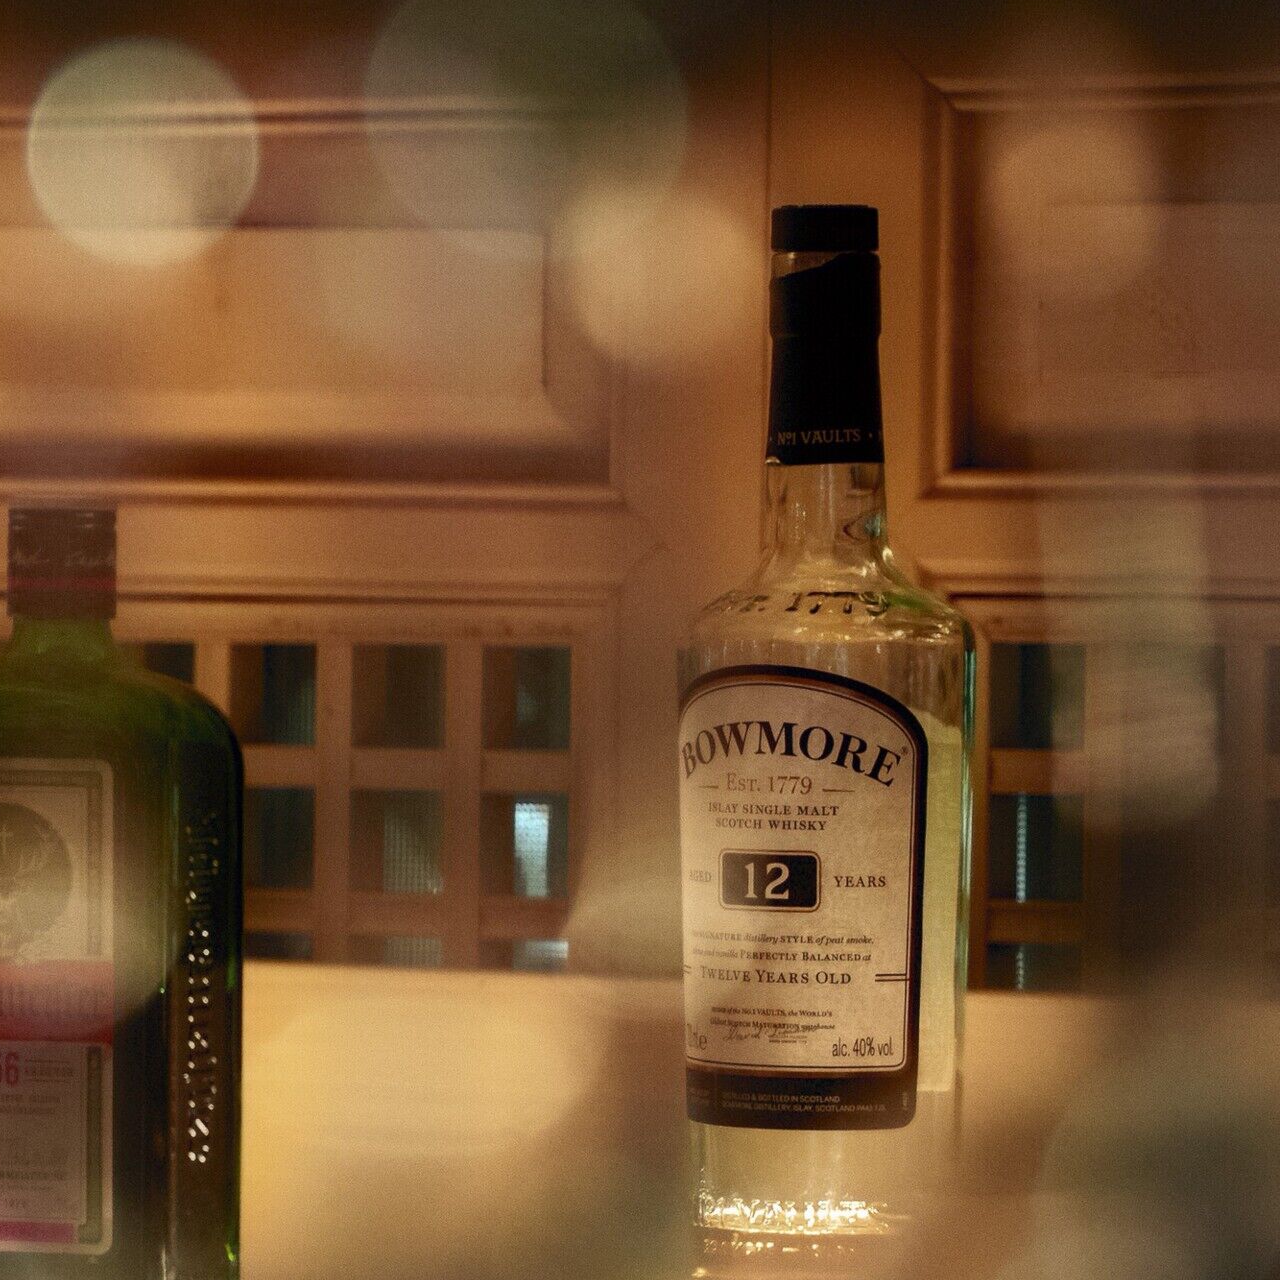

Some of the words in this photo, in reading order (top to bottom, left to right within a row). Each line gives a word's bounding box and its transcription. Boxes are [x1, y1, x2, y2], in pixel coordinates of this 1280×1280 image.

[800, 428, 862, 446] VAULTS
[682, 720, 901, 787] BOWMORE
[768, 775, 813, 795] 1779
[708, 802, 738, 815] ISLAY
[742, 803, 792, 816] SINGLE
[797, 805, 840, 816] MALT
[715, 816, 763, 830] SCOTCH
[768, 819, 827, 831] WHISKY
[744, 862, 791, 901] 12
[833, 874, 887, 888] YEARS
[743, 931, 779, 945] distillery
[780, 935, 814, 944] STYLE
[815, 935, 826, 945] of
[825, 936, 844, 946] peat
[846, 935, 875, 945] smoke,
[739, 949, 798, 962] PERFECTLY
[802, 952, 861, 962] BALANCED
[862, 953, 872, 962] at
[700, 964, 751, 983] TWELVE
[755, 968, 810, 985] YEARS
[815, 970, 852, 985] OLD
[832, 1036, 851, 1057] alc.
[852, 1036, 875, 1058] 40%
[877, 1038, 894, 1057] vol
[758, 1094, 790, 1102] BOTTLED
[790, 1094, 799, 1103] IN
[799, 1094, 841, 1103] SCOTLAND
[815, 1103, 855, 1112] SCOTLAND
